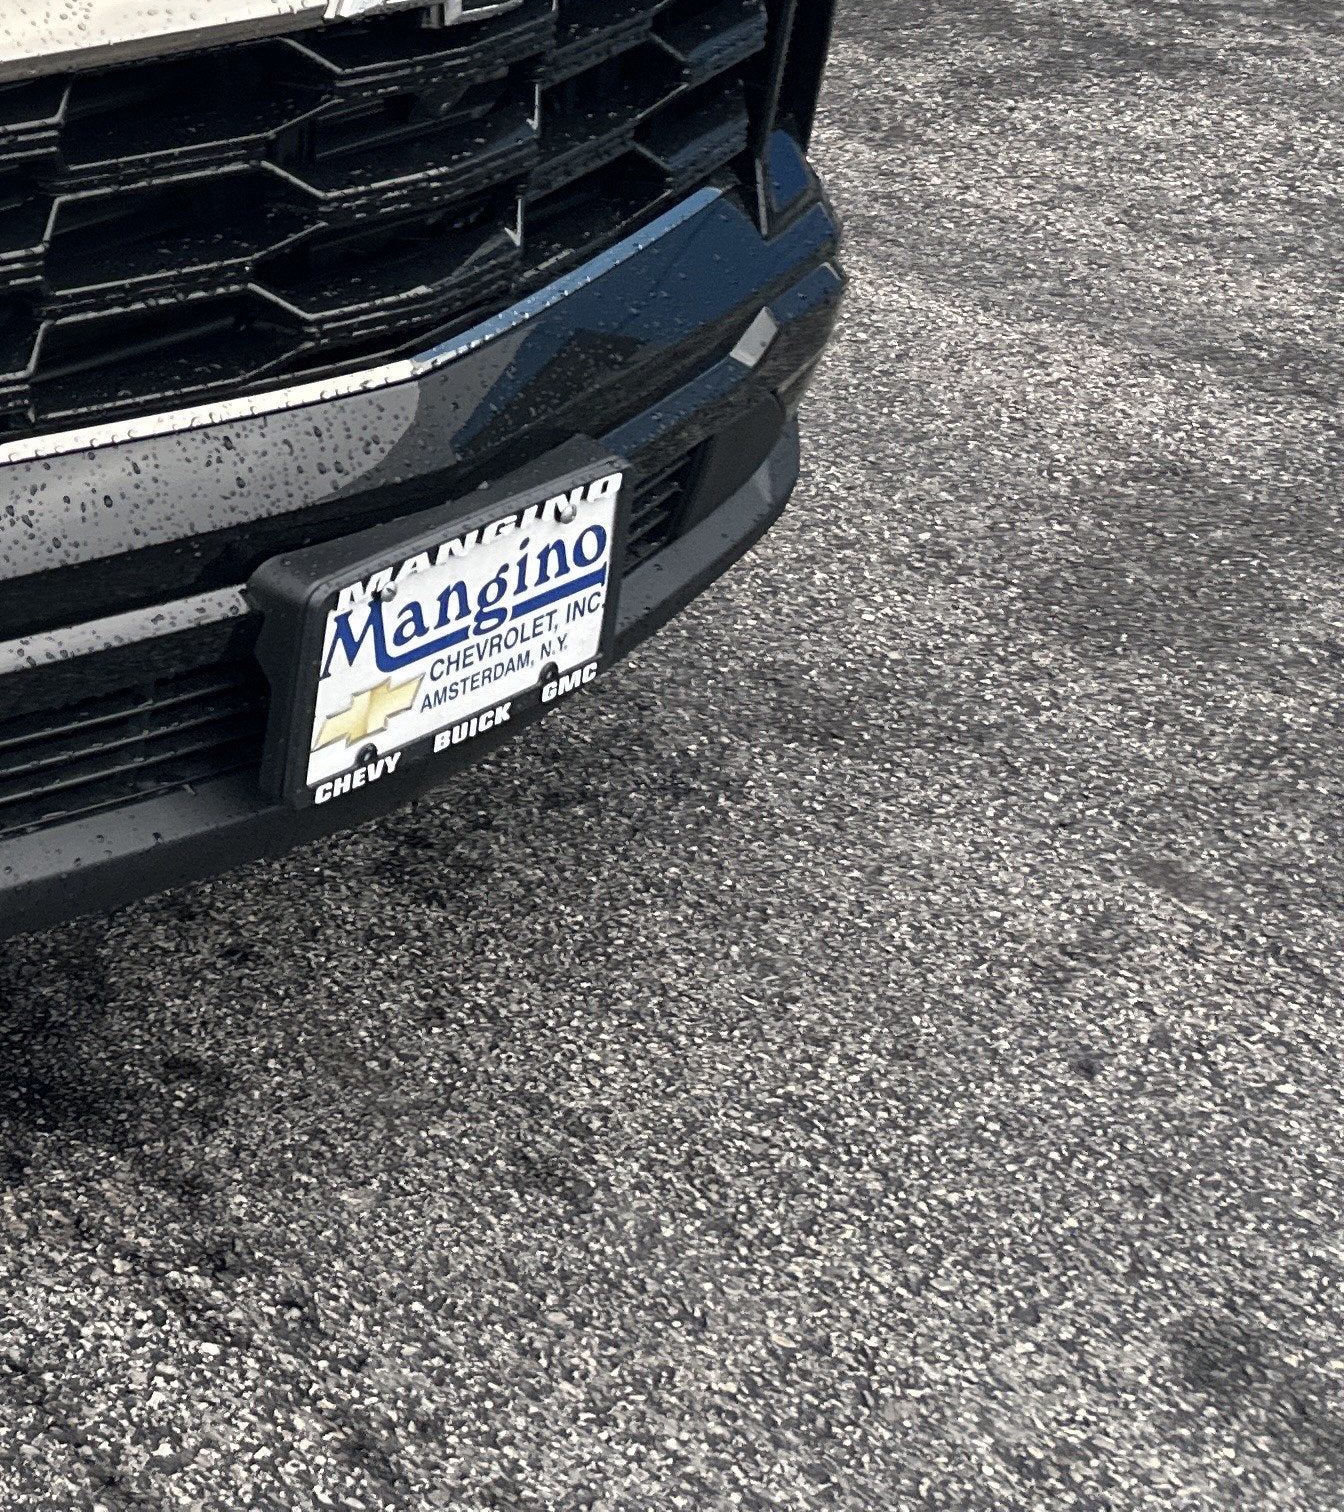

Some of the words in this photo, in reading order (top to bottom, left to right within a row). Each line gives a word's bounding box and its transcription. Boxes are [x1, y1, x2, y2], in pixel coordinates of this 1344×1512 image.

[320, 523, 608, 680] Mangino
[429, 611, 559, 683] CHEVROLET,
[565, 591, 608, 626] INC.
[420, 654, 535, 714] AMSTERDAM,
[540, 632, 569, 661] N.Y.
[314, 751, 402, 805] CHEVY
[433, 701, 512, 754] BUICK
[541, 661, 598, 703] GMC
